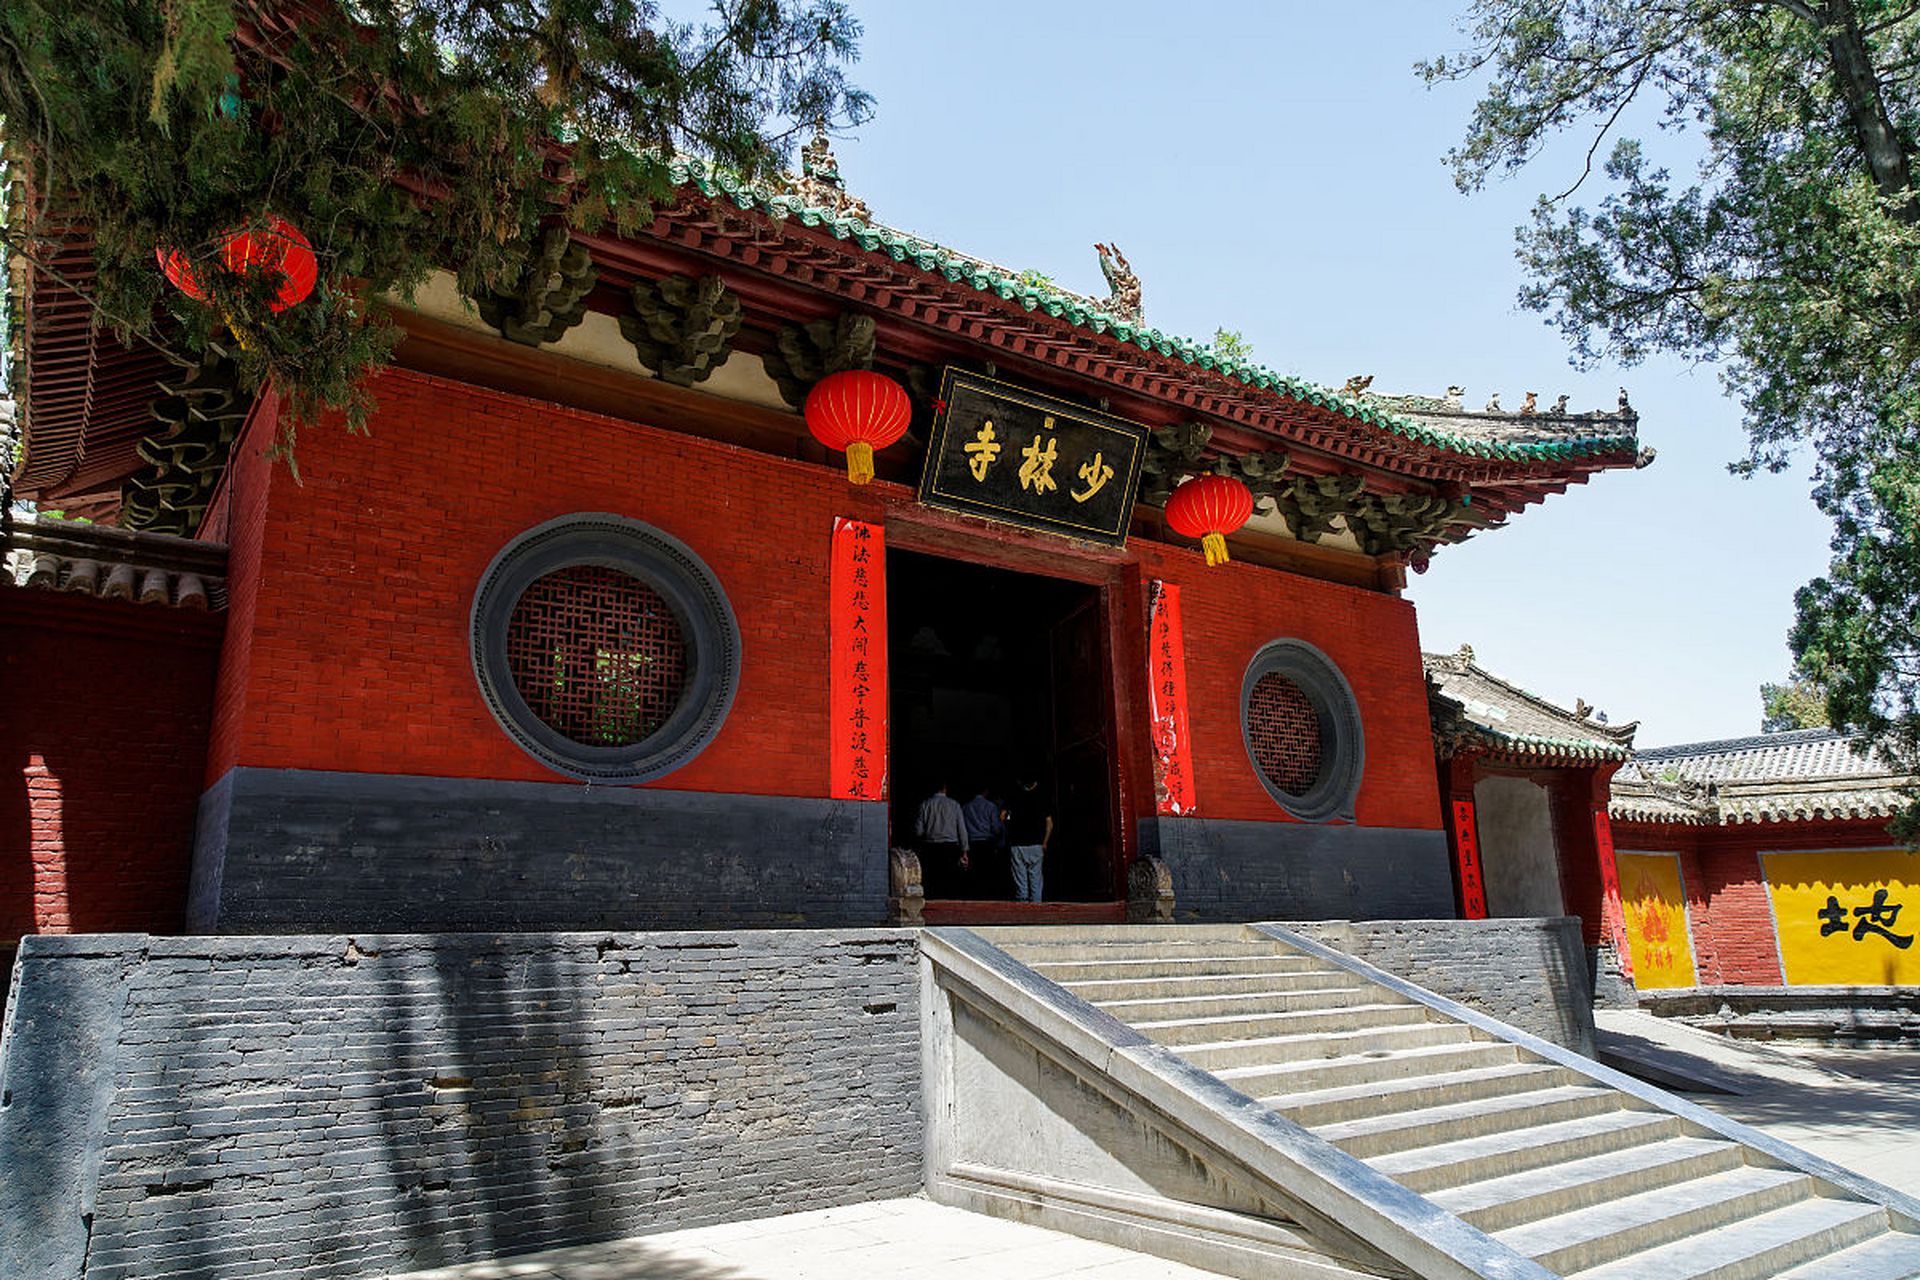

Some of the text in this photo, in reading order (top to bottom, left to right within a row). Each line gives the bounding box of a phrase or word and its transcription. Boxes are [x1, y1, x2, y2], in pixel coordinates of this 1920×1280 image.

[964, 420, 1114, 503] 少林寺
[1817, 888, 1914, 949] 地
